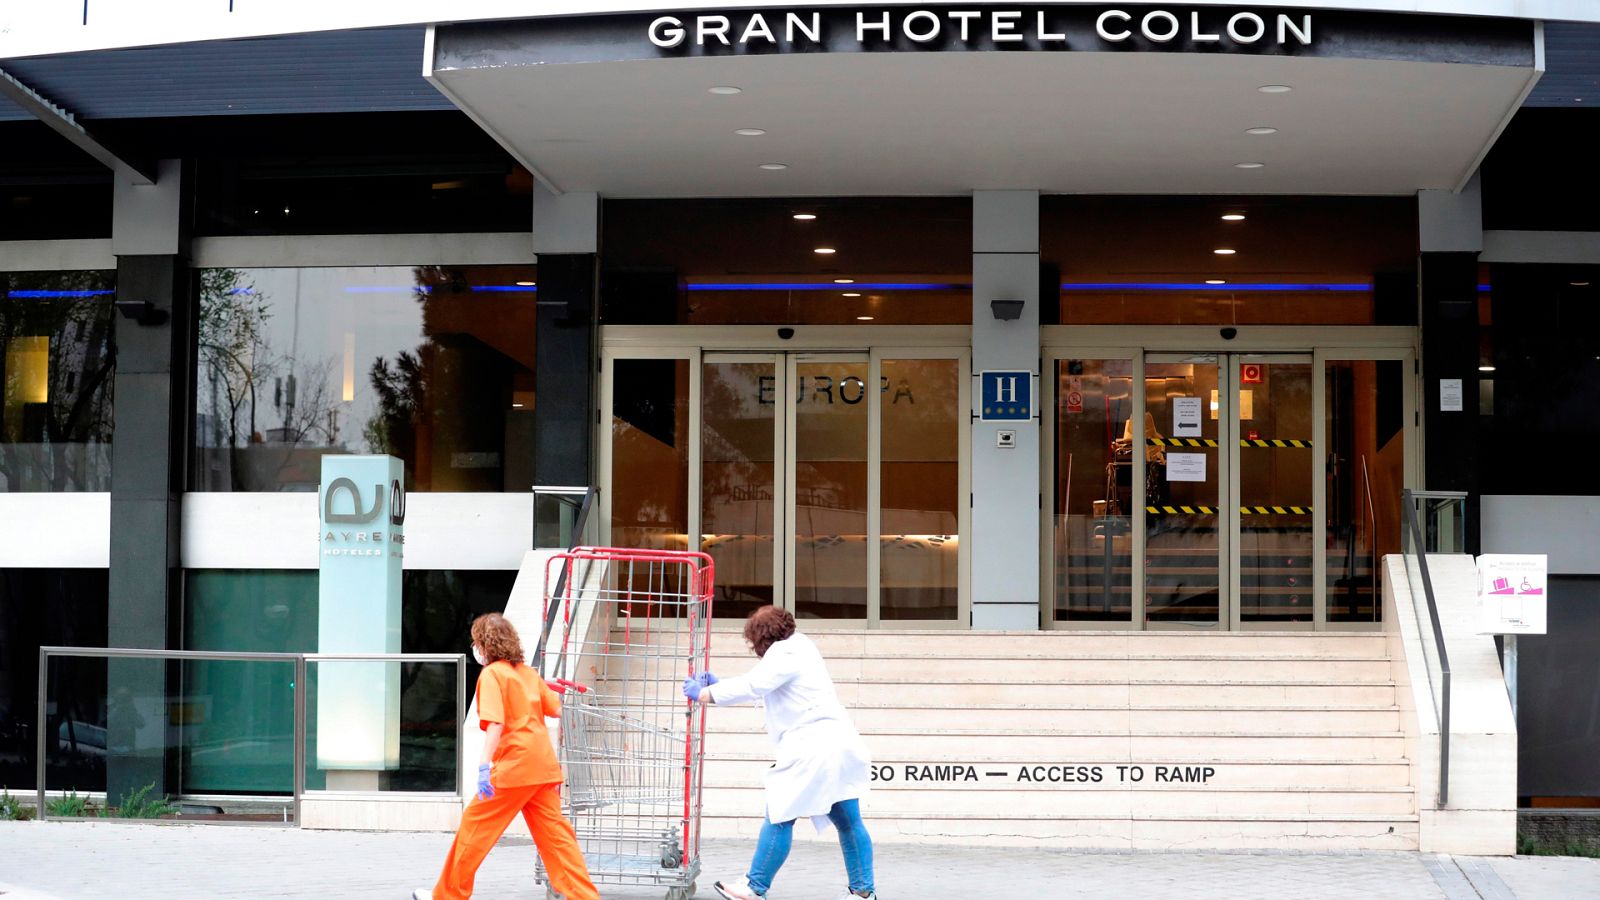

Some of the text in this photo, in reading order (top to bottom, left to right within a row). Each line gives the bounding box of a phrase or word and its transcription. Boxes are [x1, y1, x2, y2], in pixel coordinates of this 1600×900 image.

[648, 9, 1312, 48] GRAN HOTEL COLON
[994, 376, 1018, 403] H
[325, 532, 383, 542] AYRE
[323, 548, 382, 557] HOTELES
[905, 765, 979, 781] RAMPA
[1017, 766, 1104, 782] ACCESS
[1116, 766, 1144, 782] TO
[1155, 766, 1215, 783] RAMP
